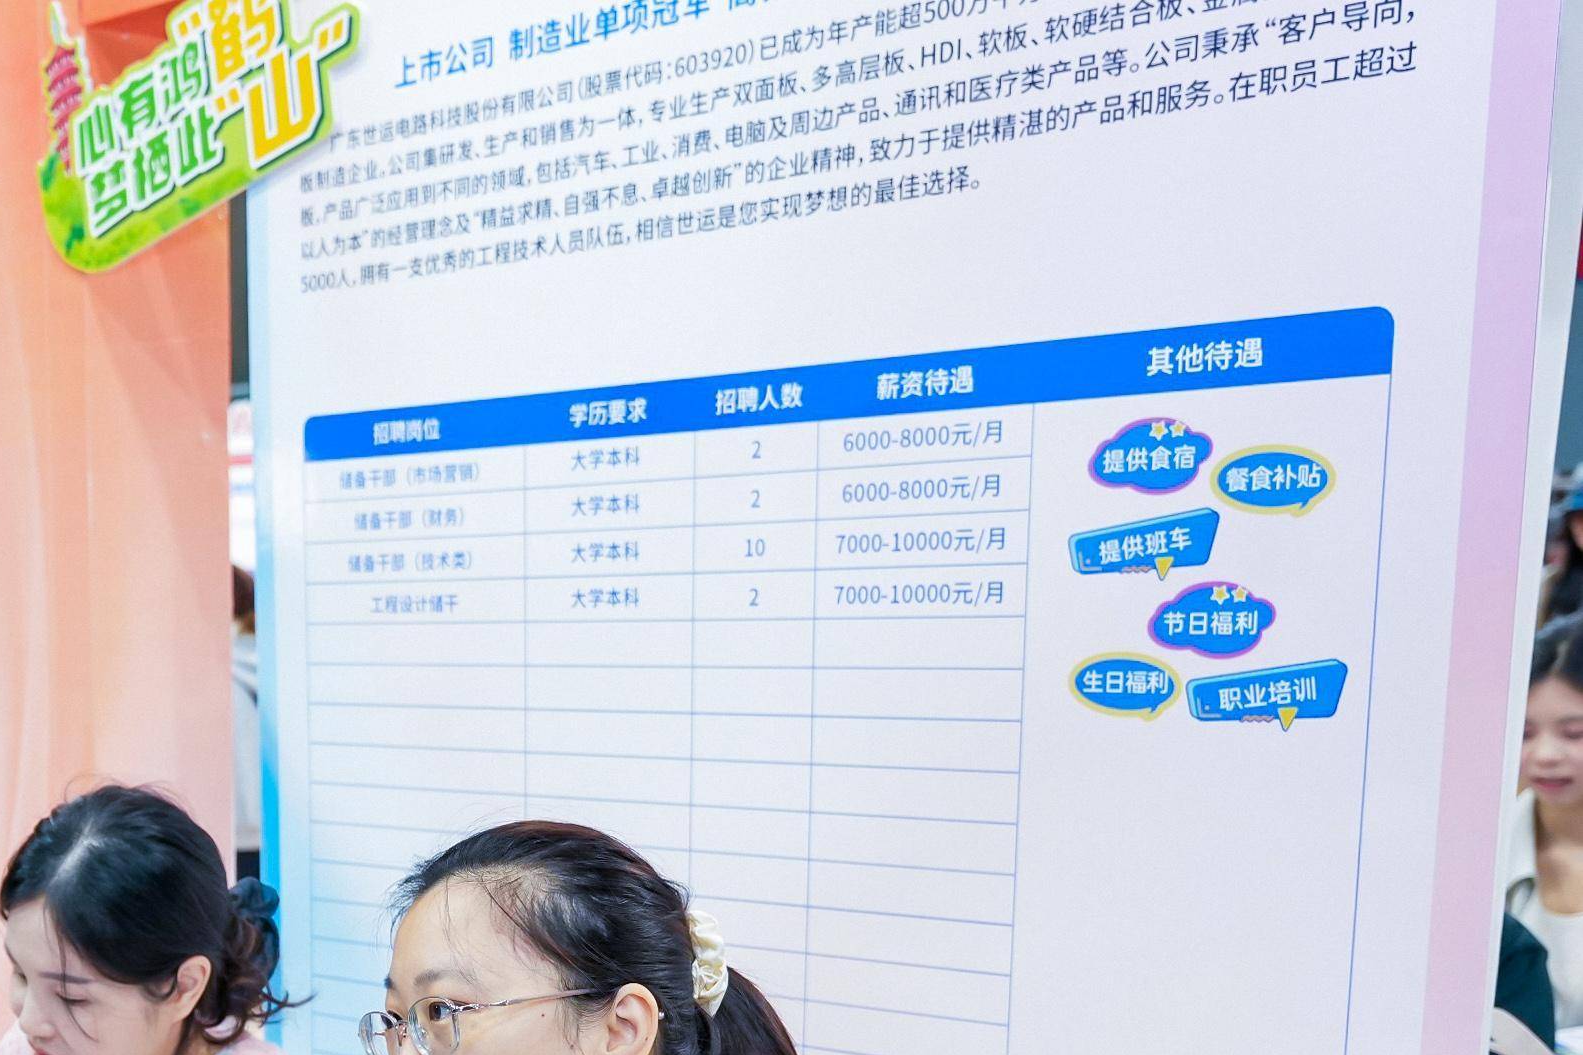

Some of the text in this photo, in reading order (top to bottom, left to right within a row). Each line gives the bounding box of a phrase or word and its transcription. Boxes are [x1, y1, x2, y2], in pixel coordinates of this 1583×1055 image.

[394, 0, 711, 89] 上市公司 制造业单项冠军
[373, 337, 1264, 445] 招聘岗位 学历要求 招聘人数 薪资待遇 其他待遇
[571, 446, 640, 471] 大学本科
[751, 440, 762, 460] 2
[843, 419, 1003, 453] 6000-8000元/月
[1102, 444, 1196, 475] 提供食宿
[571, 494, 640, 517] 大学本科
[750, 490, 761, 509] 2
[841, 473, 1001, 504] 6000-8000元/月
[1225, 464, 1323, 493] 餐食补贴
[571, 541, 640, 564] 大学本科
[744, 538, 766, 558] 10
[836, 526, 1006, 555] 7000-10000元/月
[1098, 526, 1192, 565] 提供班车
[571, 588, 640, 608] 大学本科
[749, 588, 760, 607] 2
[834, 580, 1005, 607] 7000-10000元/月
[1163, 610, 1258, 636] 节日福利
[1082, 669, 1170, 695] 生日福利
[1218, 676, 1317, 712] 职业培训
